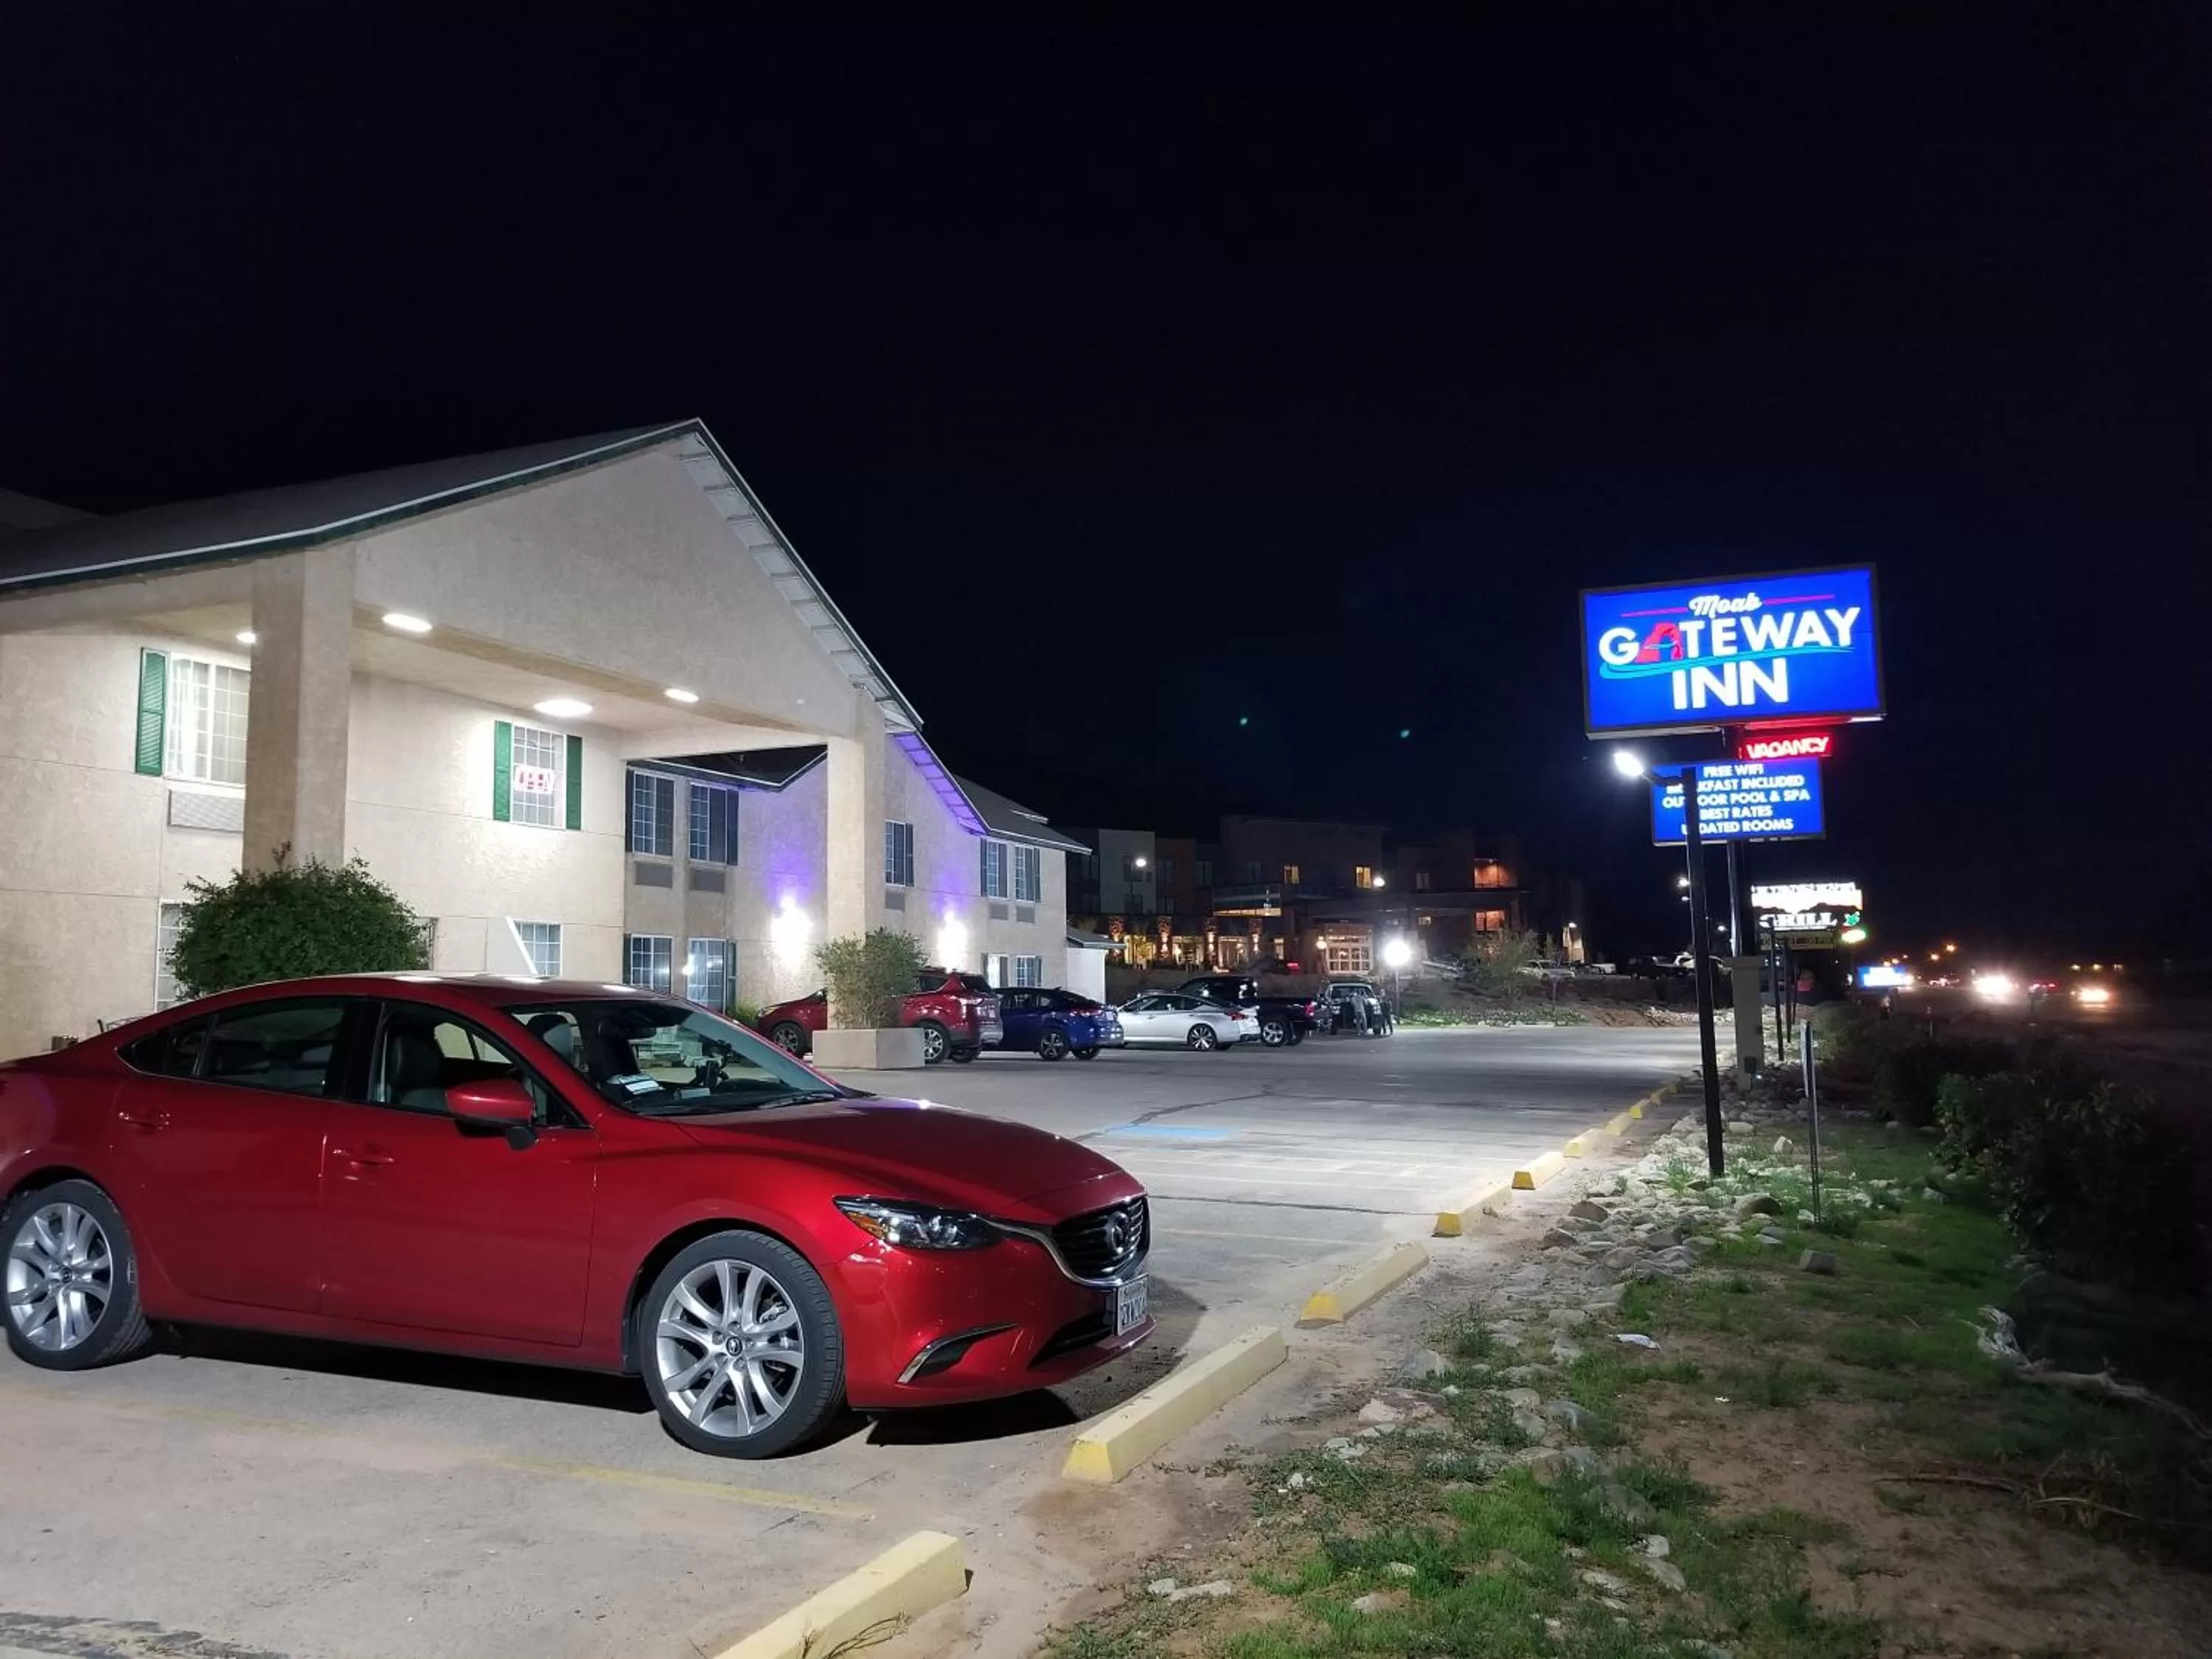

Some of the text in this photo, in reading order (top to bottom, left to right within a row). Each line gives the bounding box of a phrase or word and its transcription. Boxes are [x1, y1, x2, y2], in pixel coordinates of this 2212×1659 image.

[1688, 592, 1763, 618] Moab
[1598, 607, 1860, 665] GATEWAY
[1672, 658, 1790, 709] INN
[1746, 737, 1829, 759] VACANCY
[1703, 763, 1764, 778] FREE WIFI
[1741, 775, 1805, 790] INCLUDED
[1662, 788, 1810, 809] OUOOR POOL & SPA
[1700, 804, 1773, 821] BEST RATES
[1742, 818, 1794, 832] ROOMS
